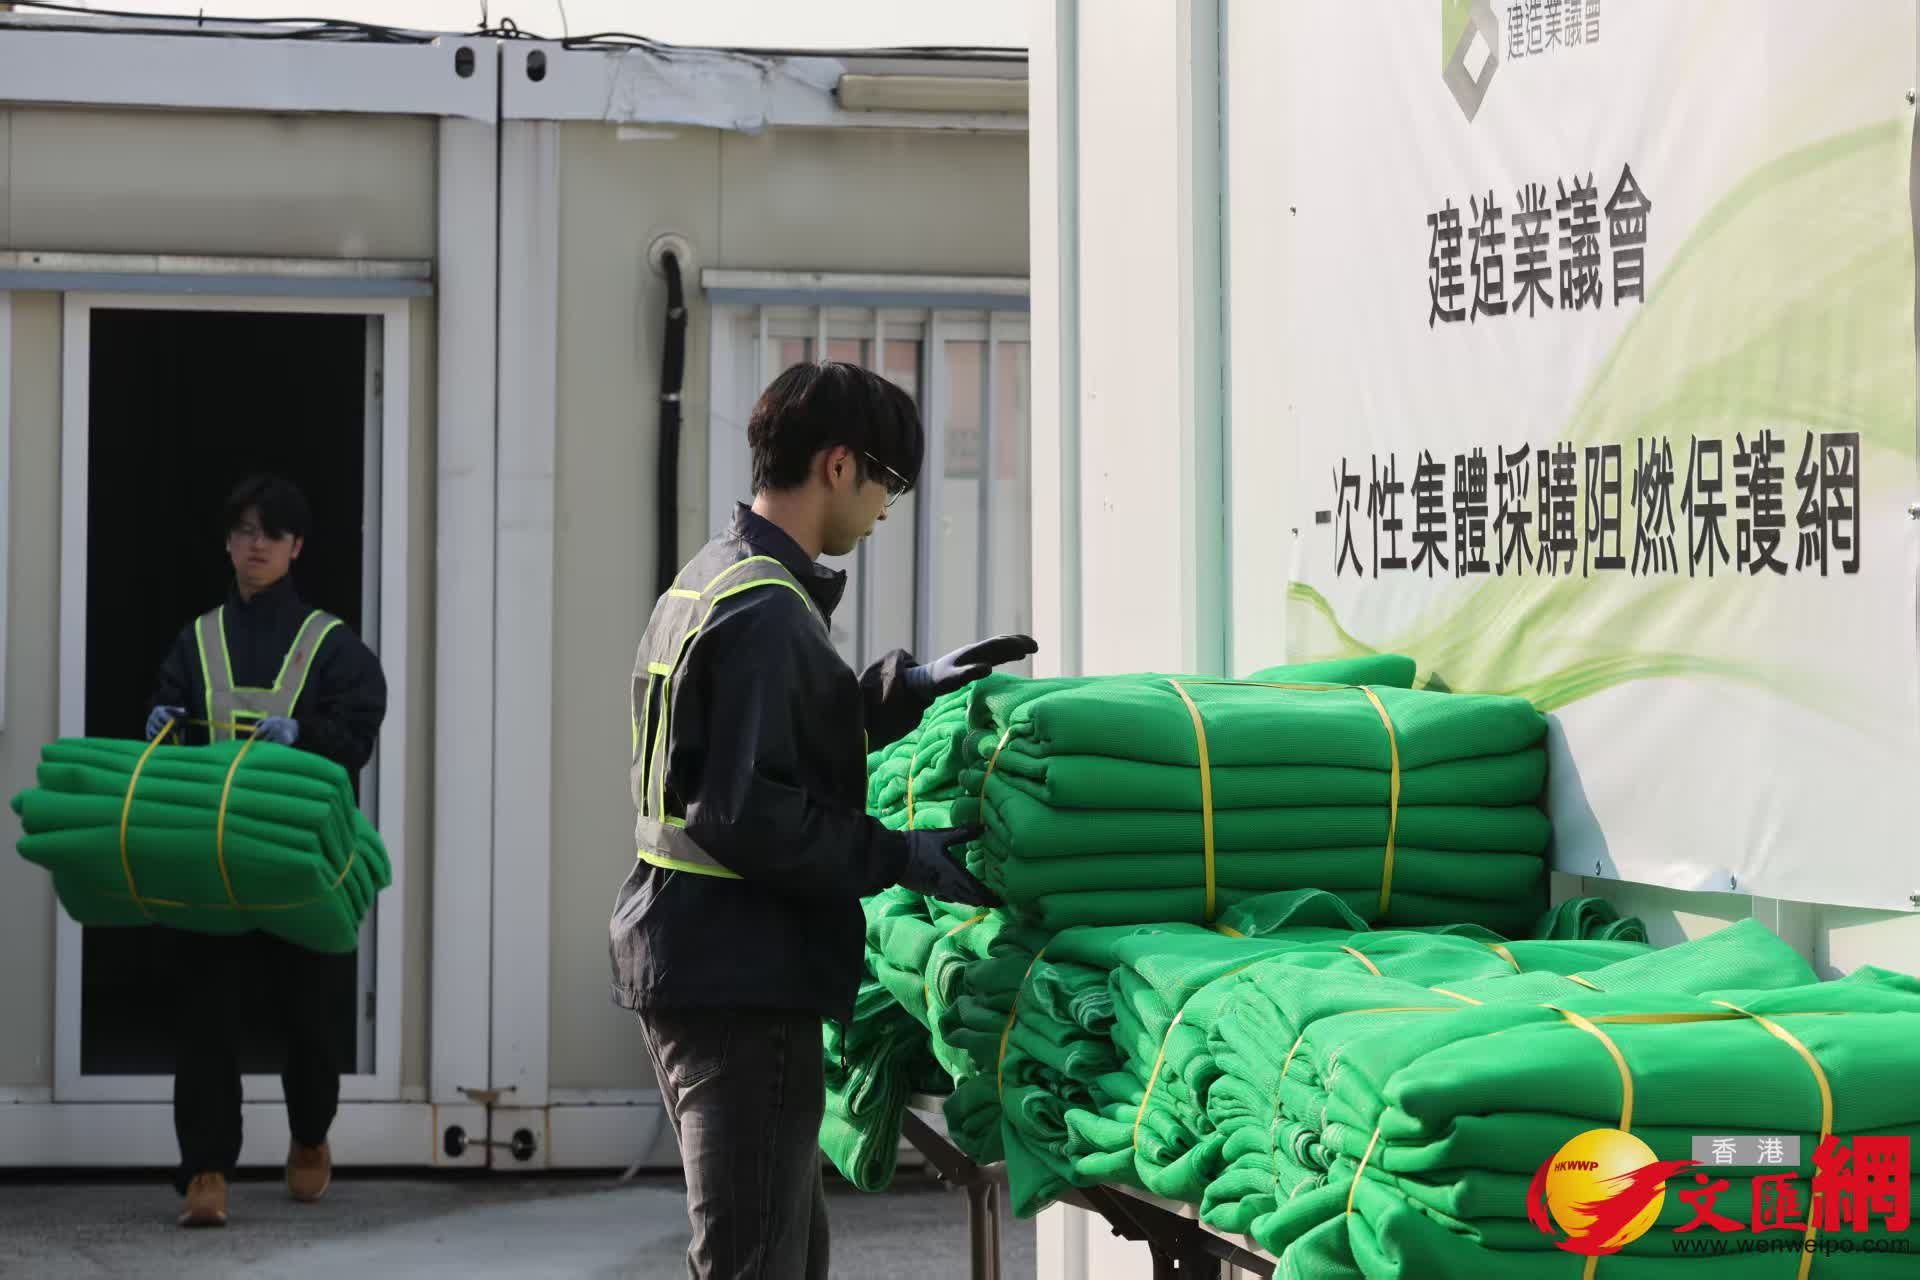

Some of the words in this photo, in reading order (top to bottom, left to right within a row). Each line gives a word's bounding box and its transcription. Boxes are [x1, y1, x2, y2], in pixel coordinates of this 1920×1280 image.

[1427, 163, 1652, 328] 建造業議會
[1315, 429, 1861, 578] 一次性集體採購阻燃保護網
